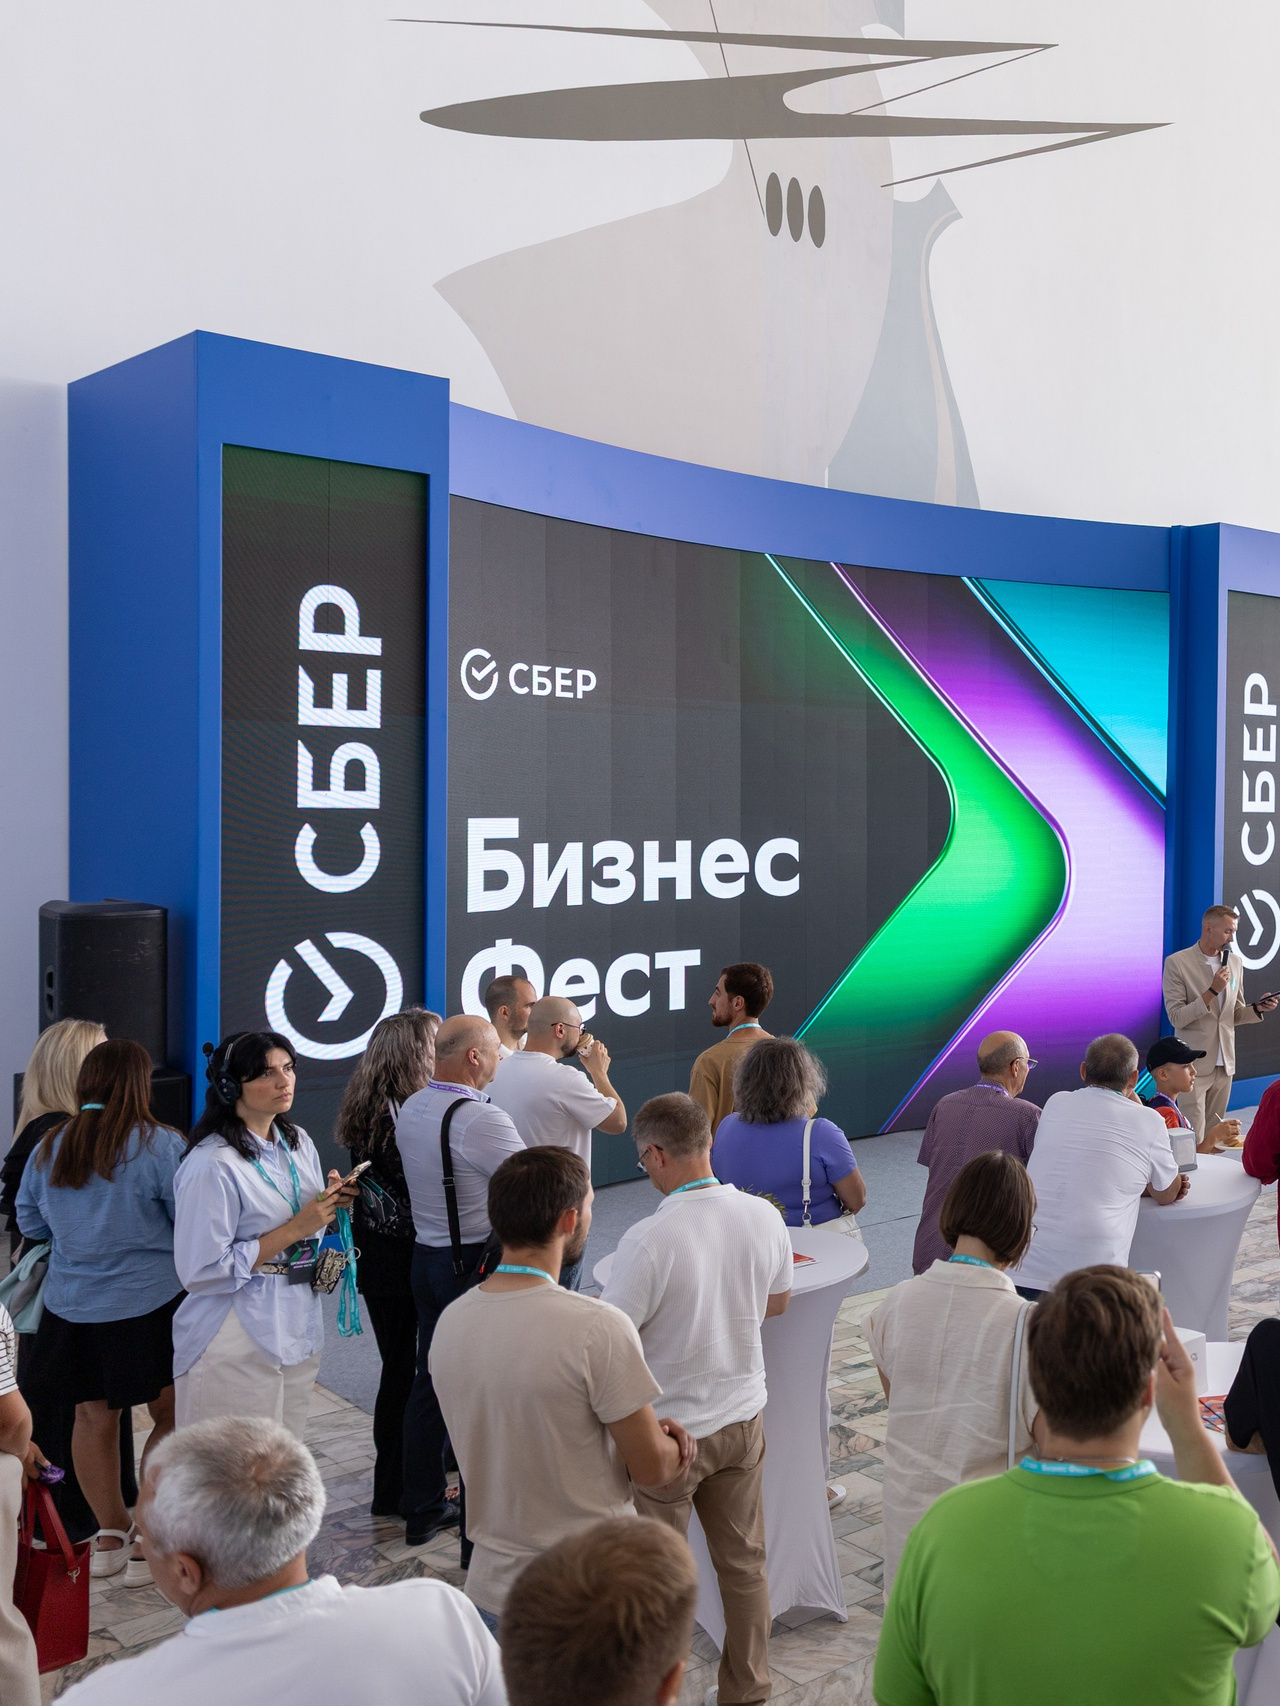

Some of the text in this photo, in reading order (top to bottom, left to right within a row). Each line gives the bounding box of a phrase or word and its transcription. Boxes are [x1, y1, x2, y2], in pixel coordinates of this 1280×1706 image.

[508, 662, 597, 699] СБЕР
[294, 584, 382, 893] СБЕР
[1240, 672, 1278, 866] СБЕР
[466, 817, 800, 913] Бизнес
[461, 938, 701, 1022] Фест
